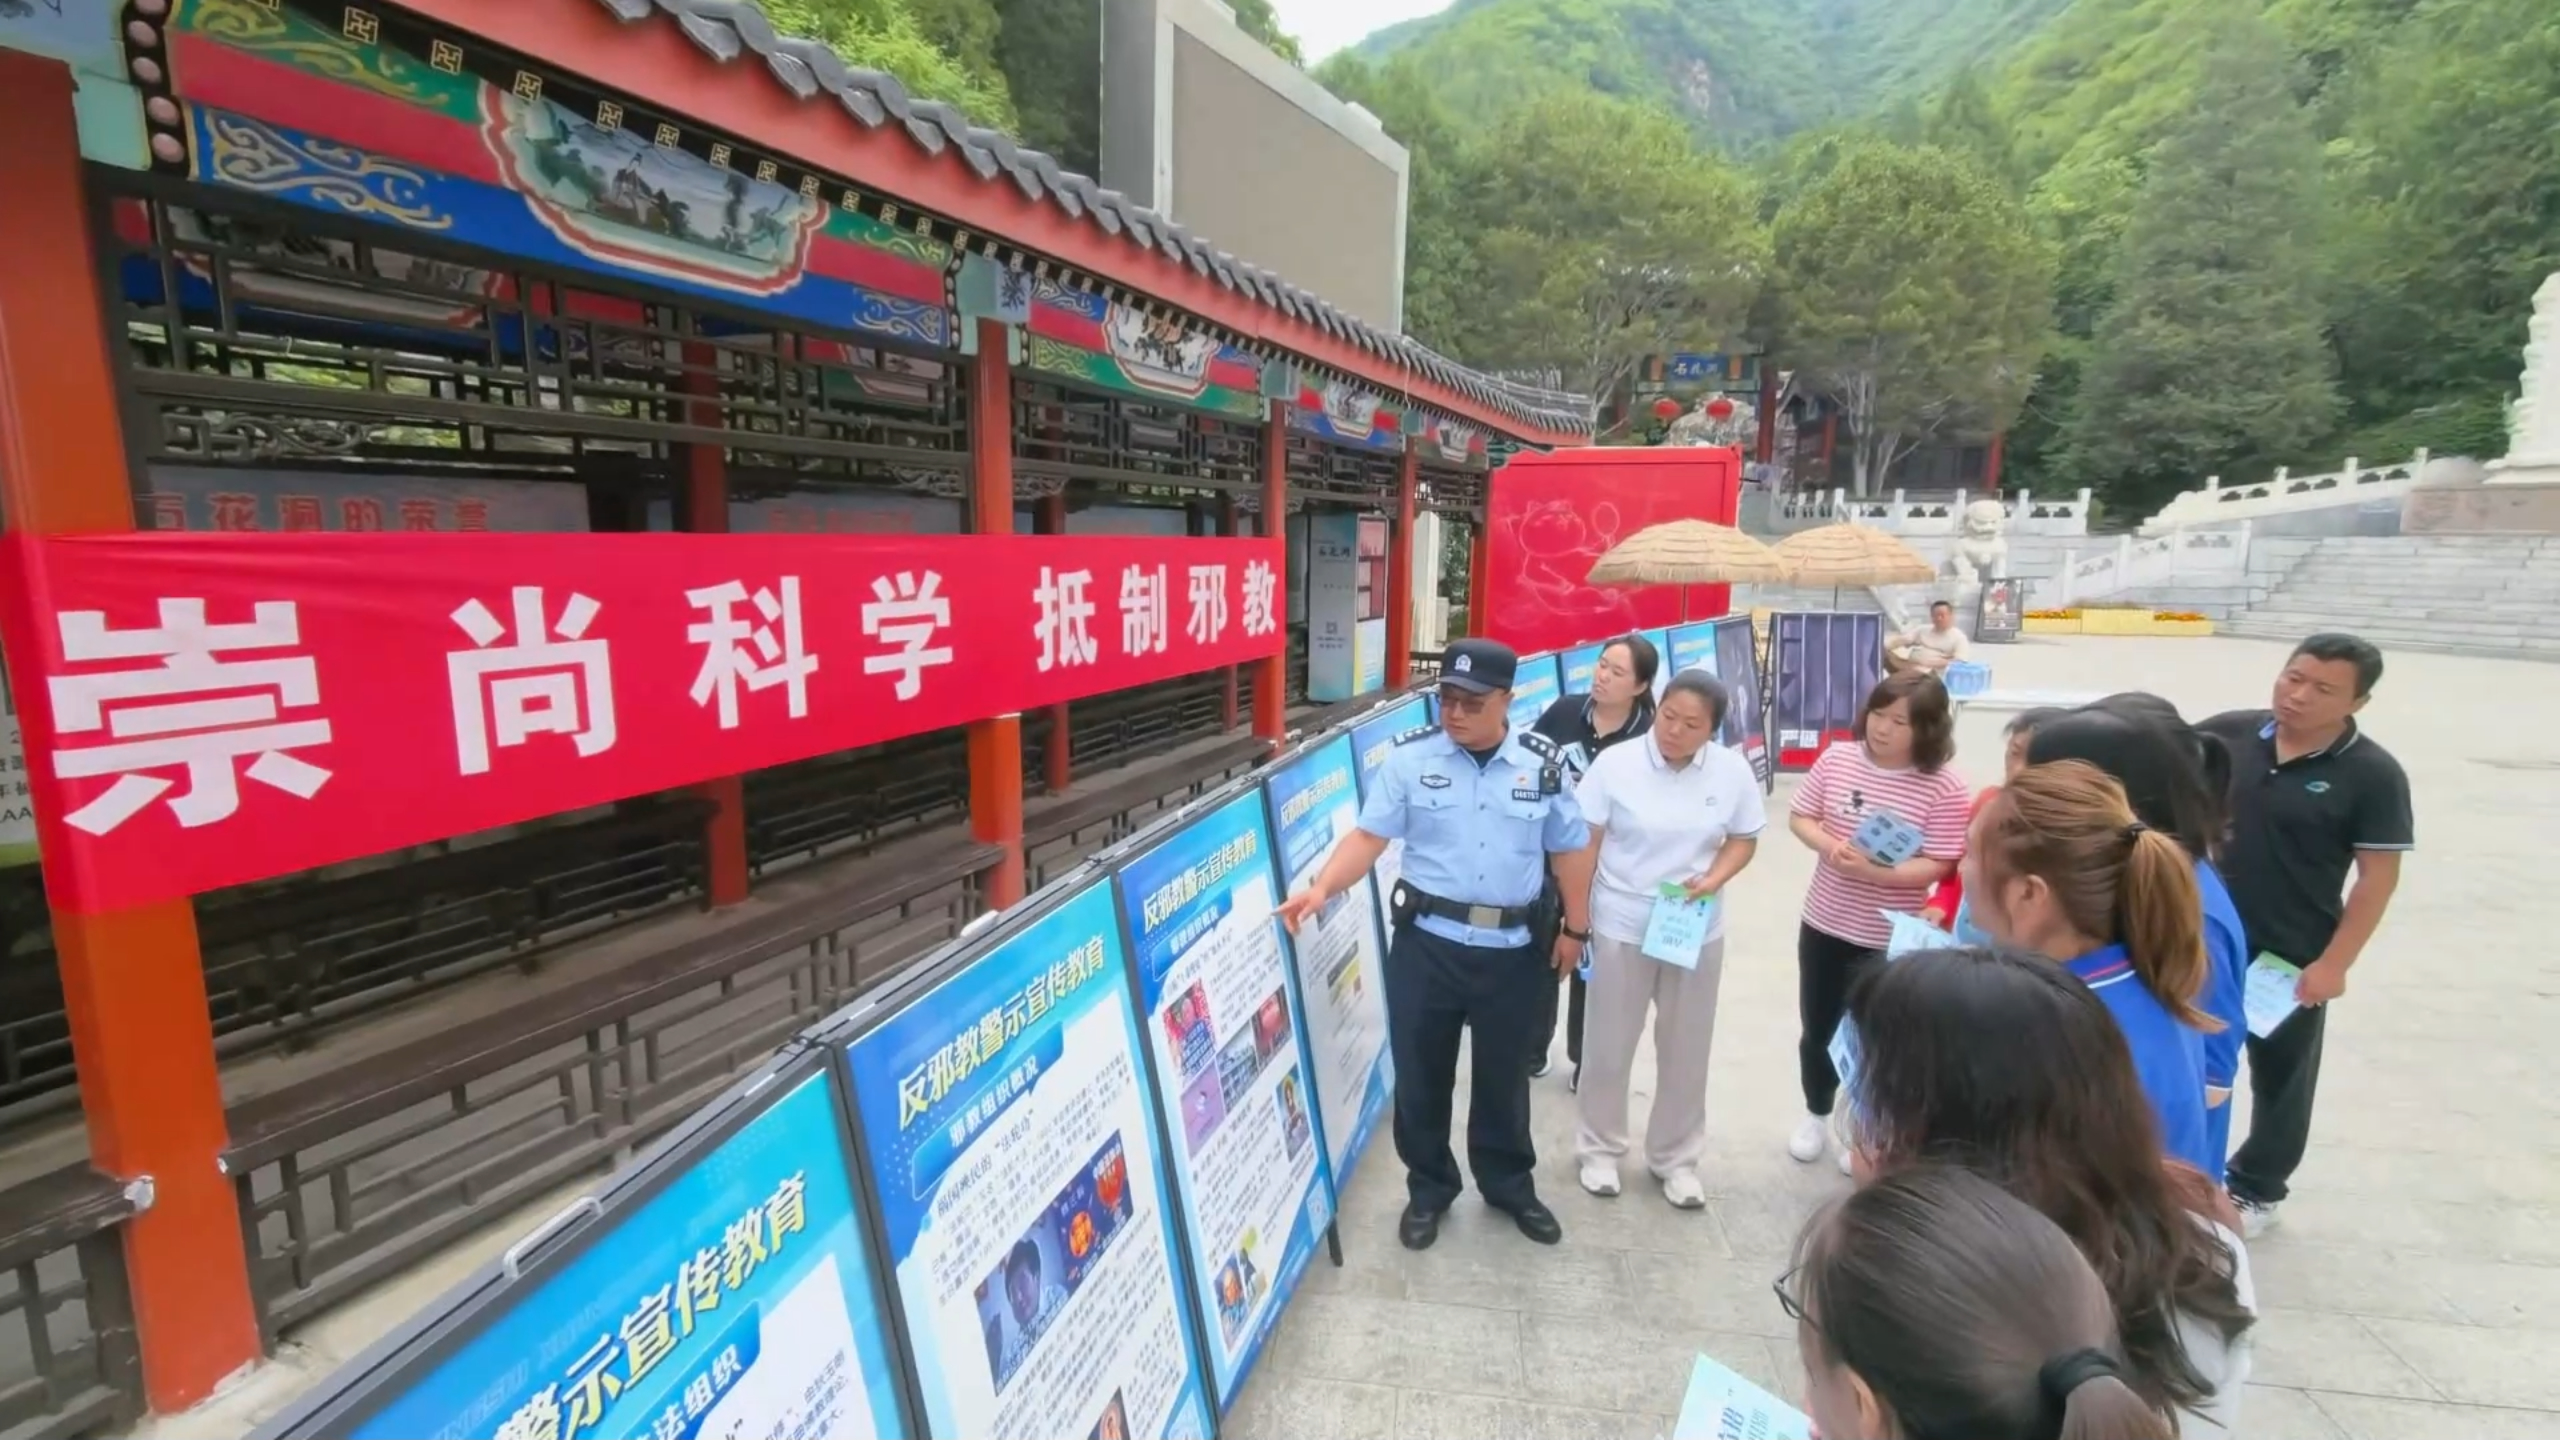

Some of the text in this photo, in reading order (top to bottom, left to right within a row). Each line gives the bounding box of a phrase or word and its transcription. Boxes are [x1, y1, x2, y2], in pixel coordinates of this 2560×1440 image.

[47, 559, 1279, 837] 崇尚科学 抵制邪教
[1144, 829, 1257, 935] 反邪教警示宣传教育
[898, 934, 1105, 1131] 反邪教警示宣传教育
[949, 1055, 1039, 1148] 邪教组织概况
[636, 1344, 742, 1440] 法组织
